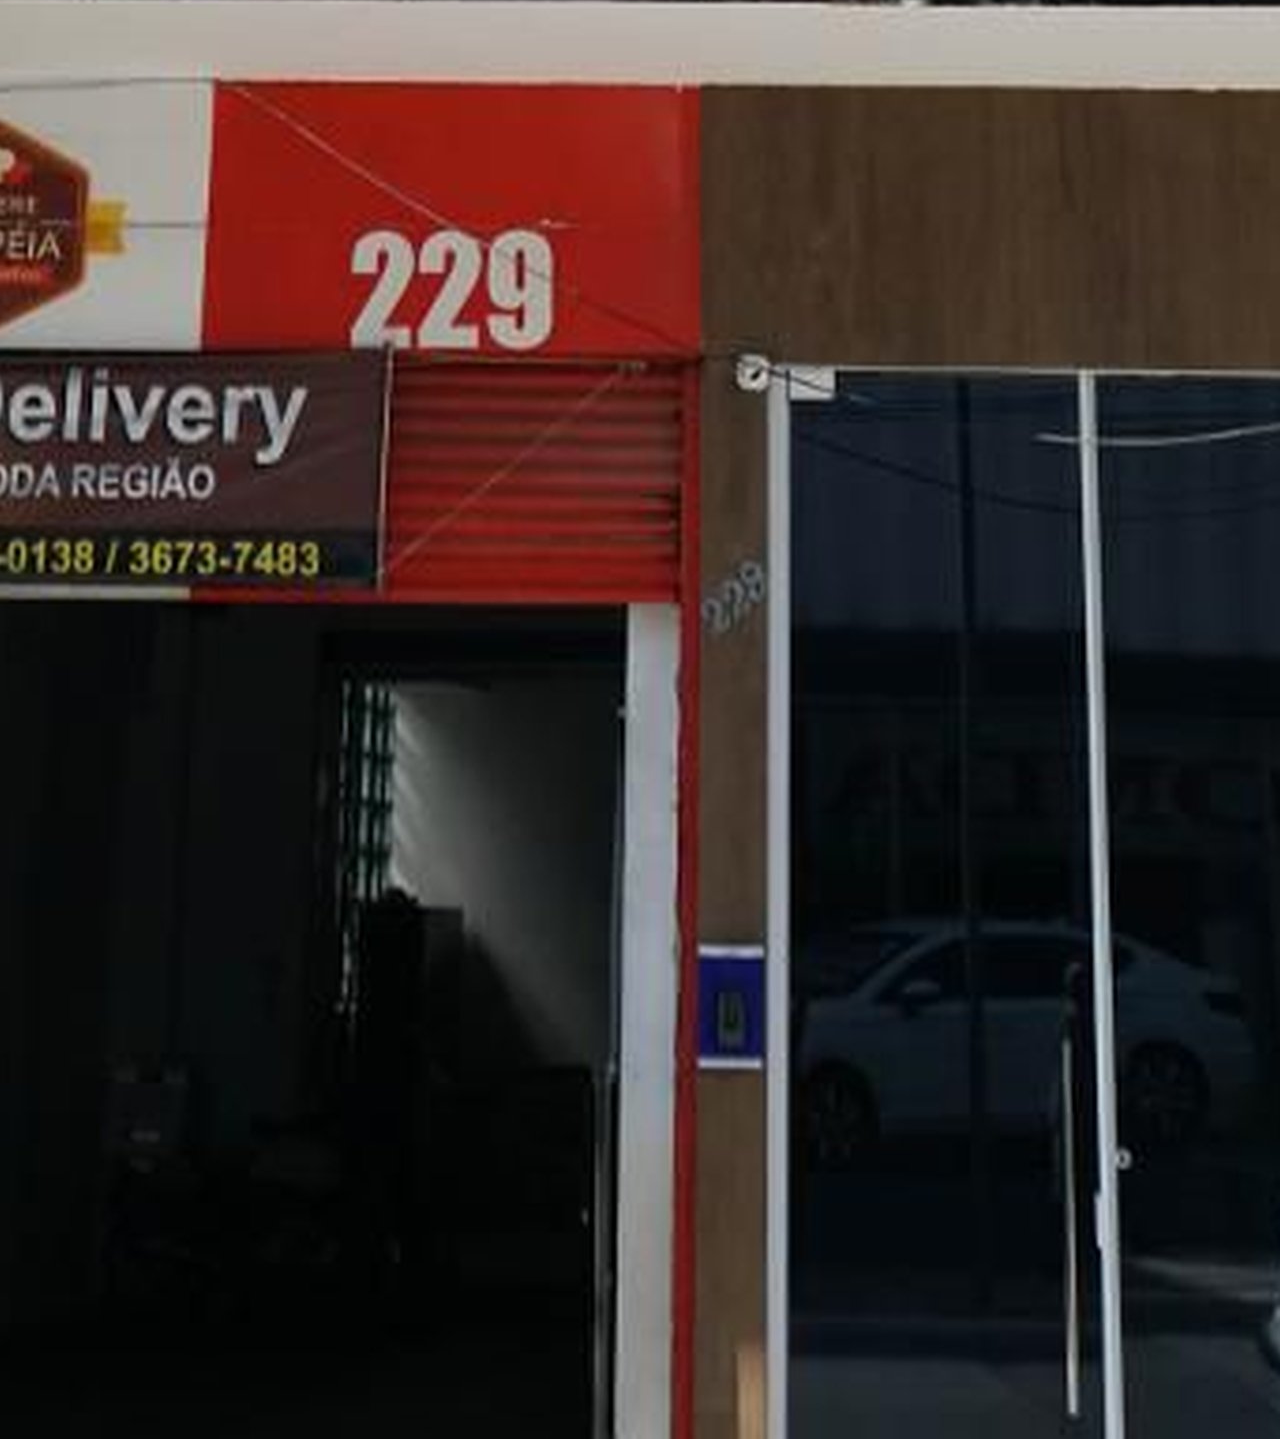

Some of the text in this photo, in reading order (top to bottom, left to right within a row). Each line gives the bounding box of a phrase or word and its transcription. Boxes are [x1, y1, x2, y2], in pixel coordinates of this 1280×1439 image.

[350, 230, 554, 351] 229
[72, 456, 216, 501] REGIÃO
[128, 539, 320, 576] 3673-7483
